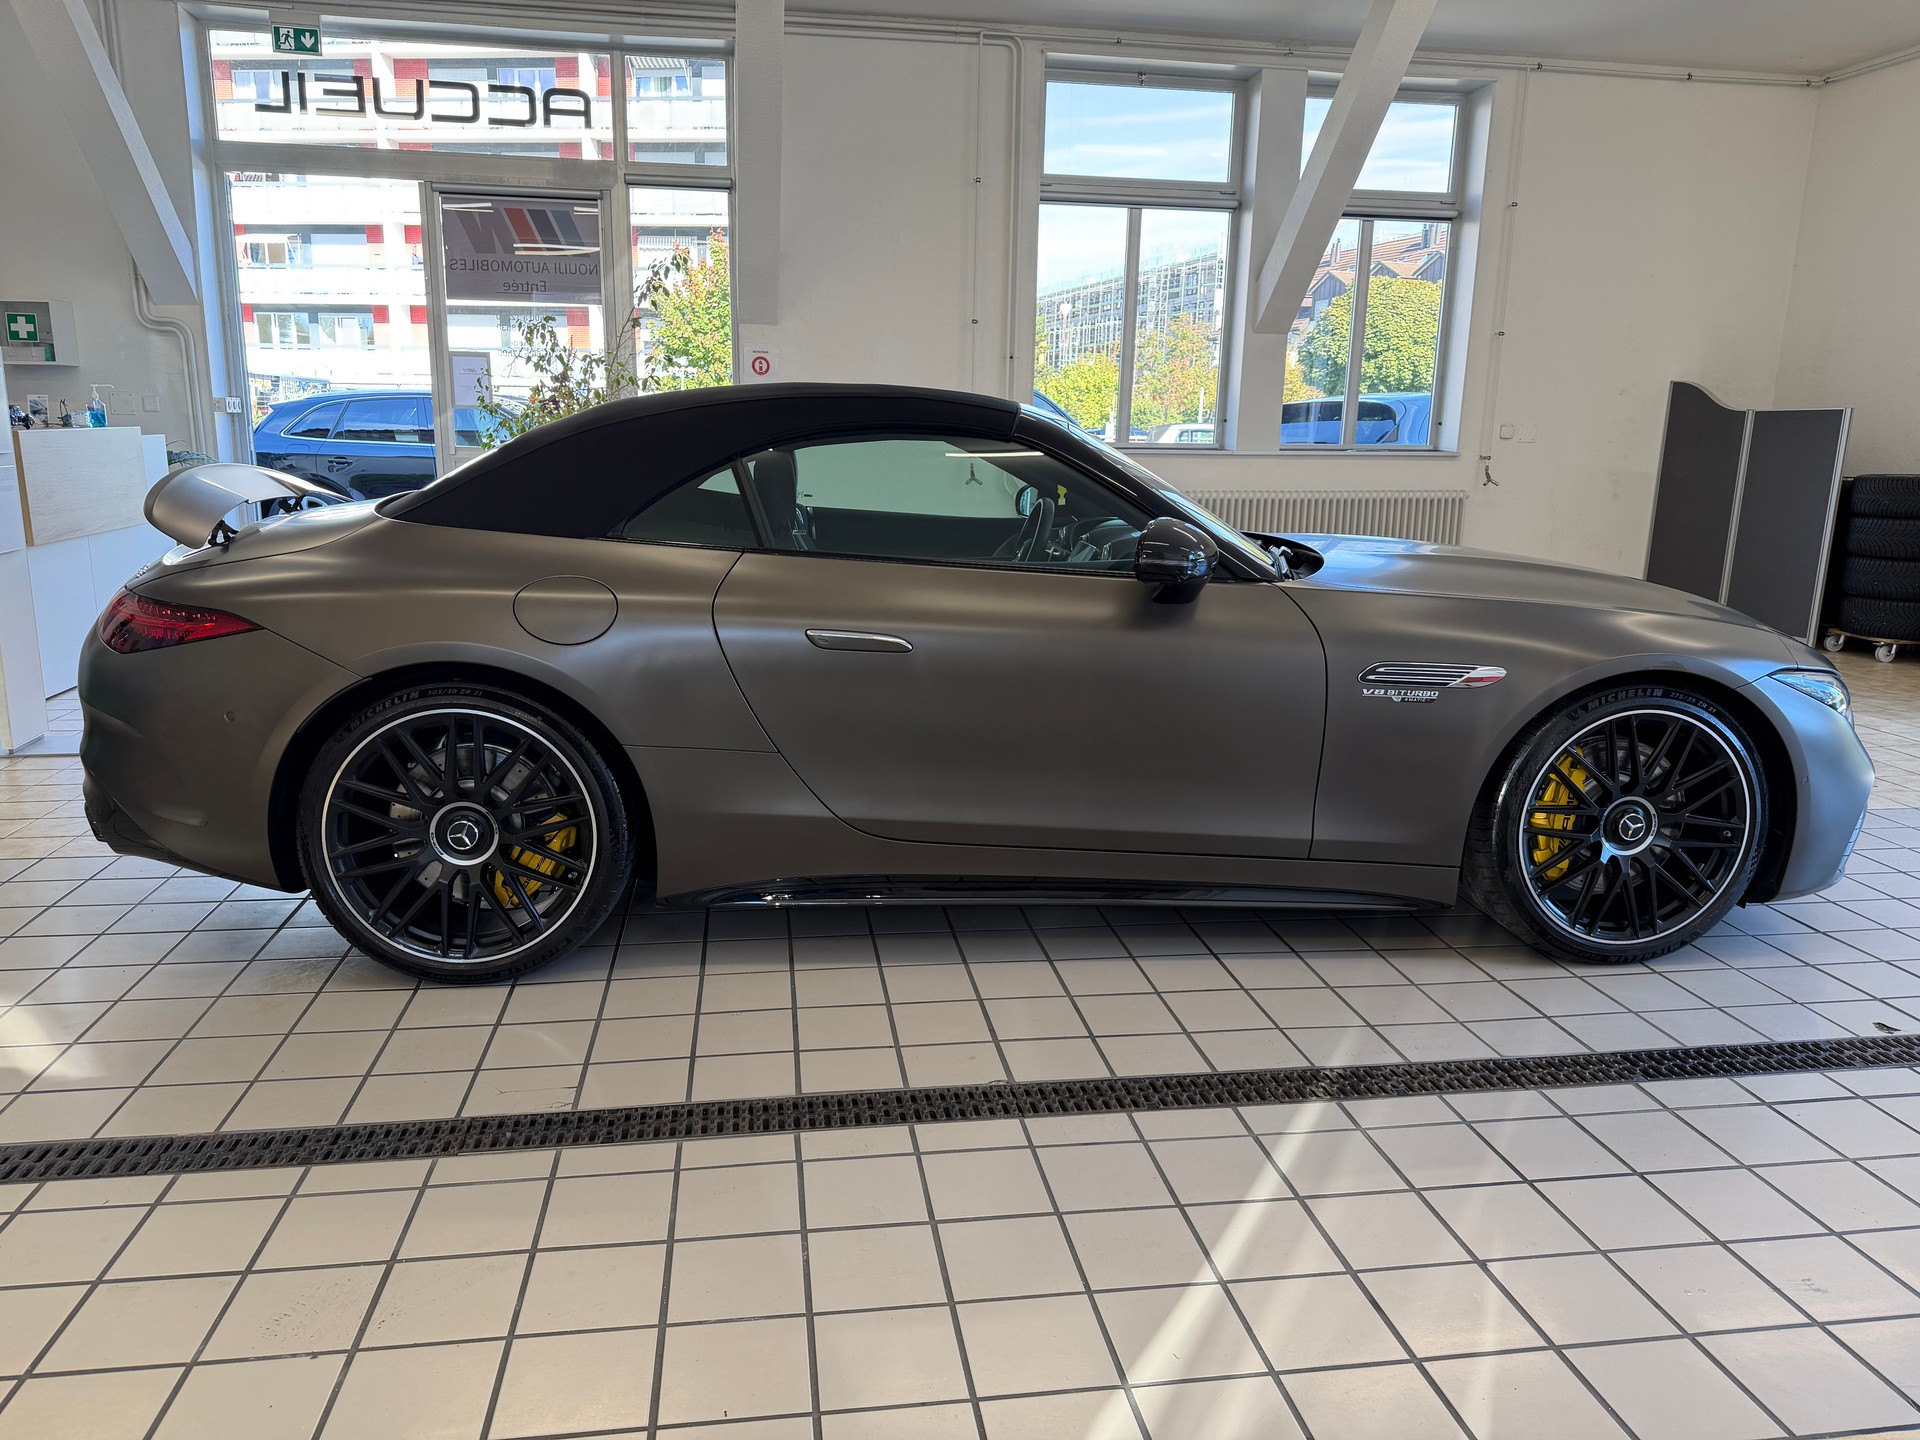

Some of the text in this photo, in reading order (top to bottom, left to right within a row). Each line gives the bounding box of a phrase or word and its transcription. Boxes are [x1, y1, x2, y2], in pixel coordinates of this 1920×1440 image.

[1387, 689, 1439, 697] BITURBO
[1588, 688, 1663, 711] MICHELIN
[350, 691, 420, 730] MICHELIN
